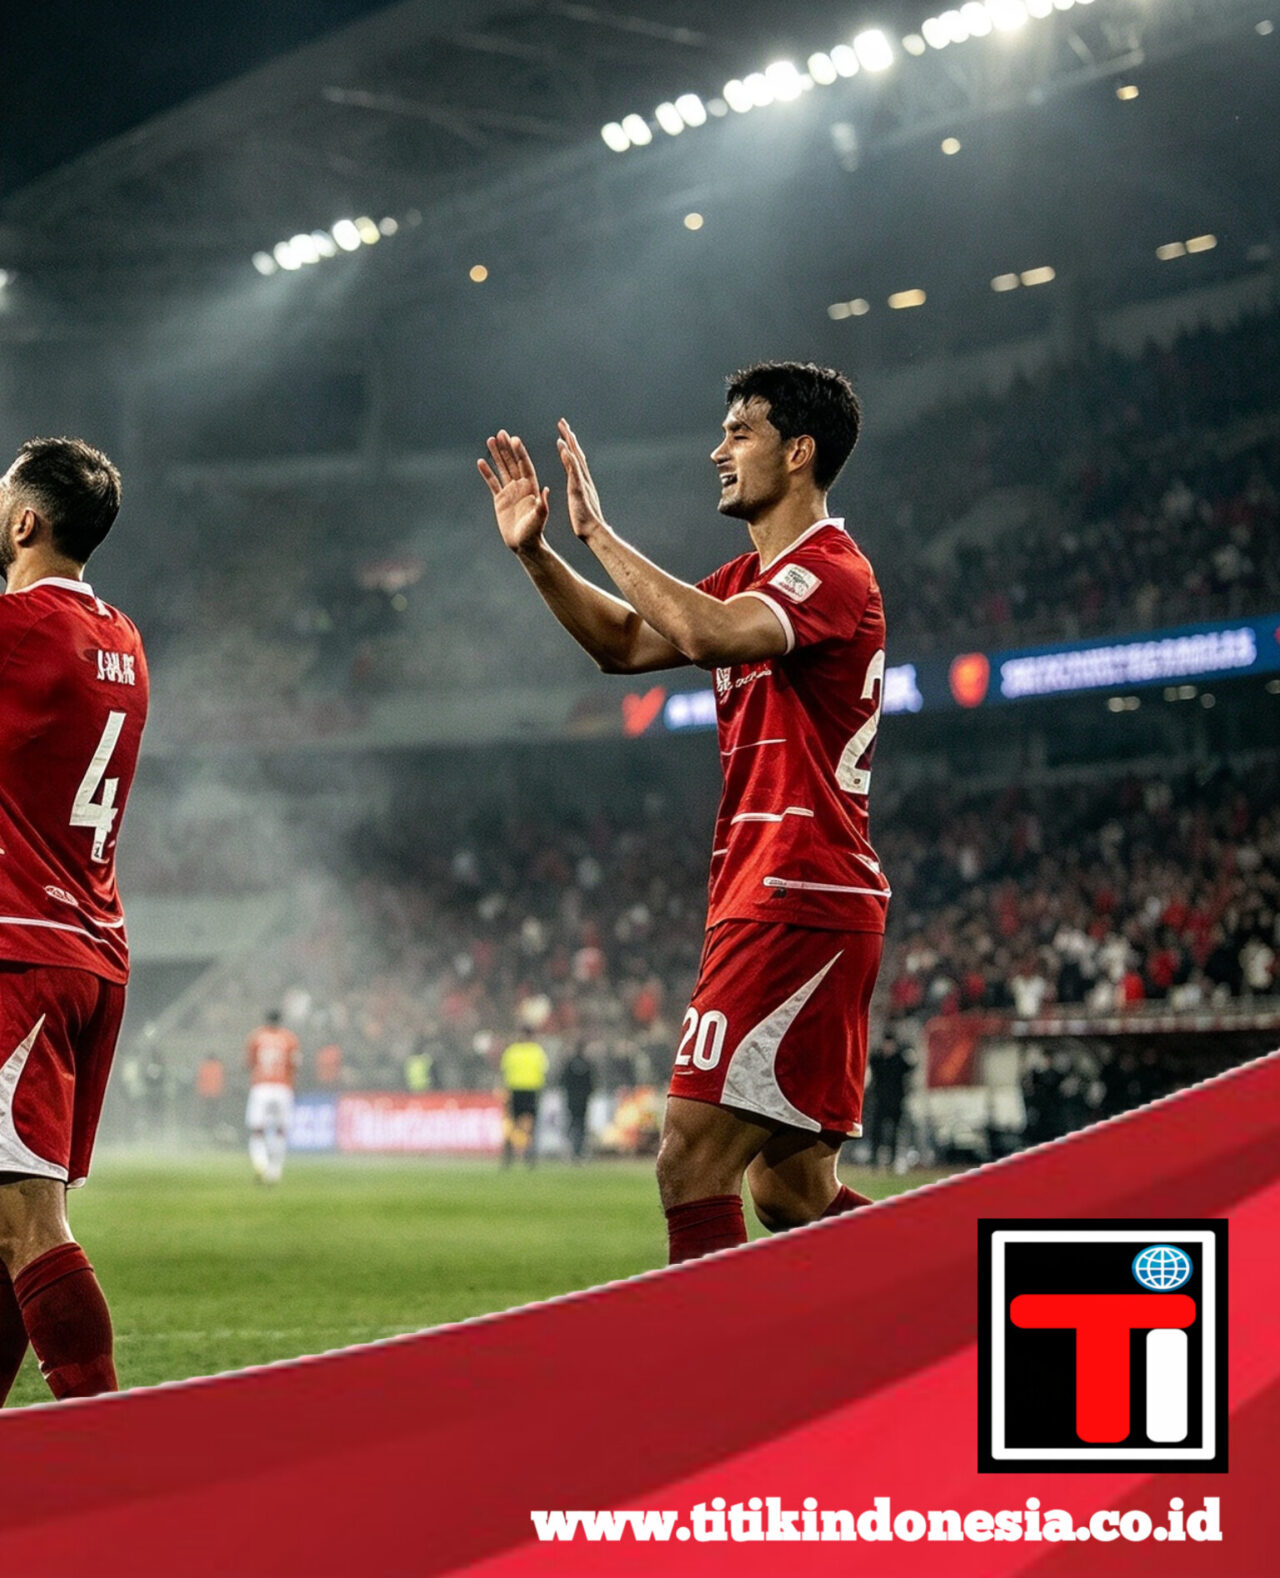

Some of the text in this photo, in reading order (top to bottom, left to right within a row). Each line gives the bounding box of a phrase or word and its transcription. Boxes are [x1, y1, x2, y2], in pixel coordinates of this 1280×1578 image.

[69, 710, 127, 863] 4
[835, 649, 885, 795] 2
[674, 1006, 728, 1071] 20
